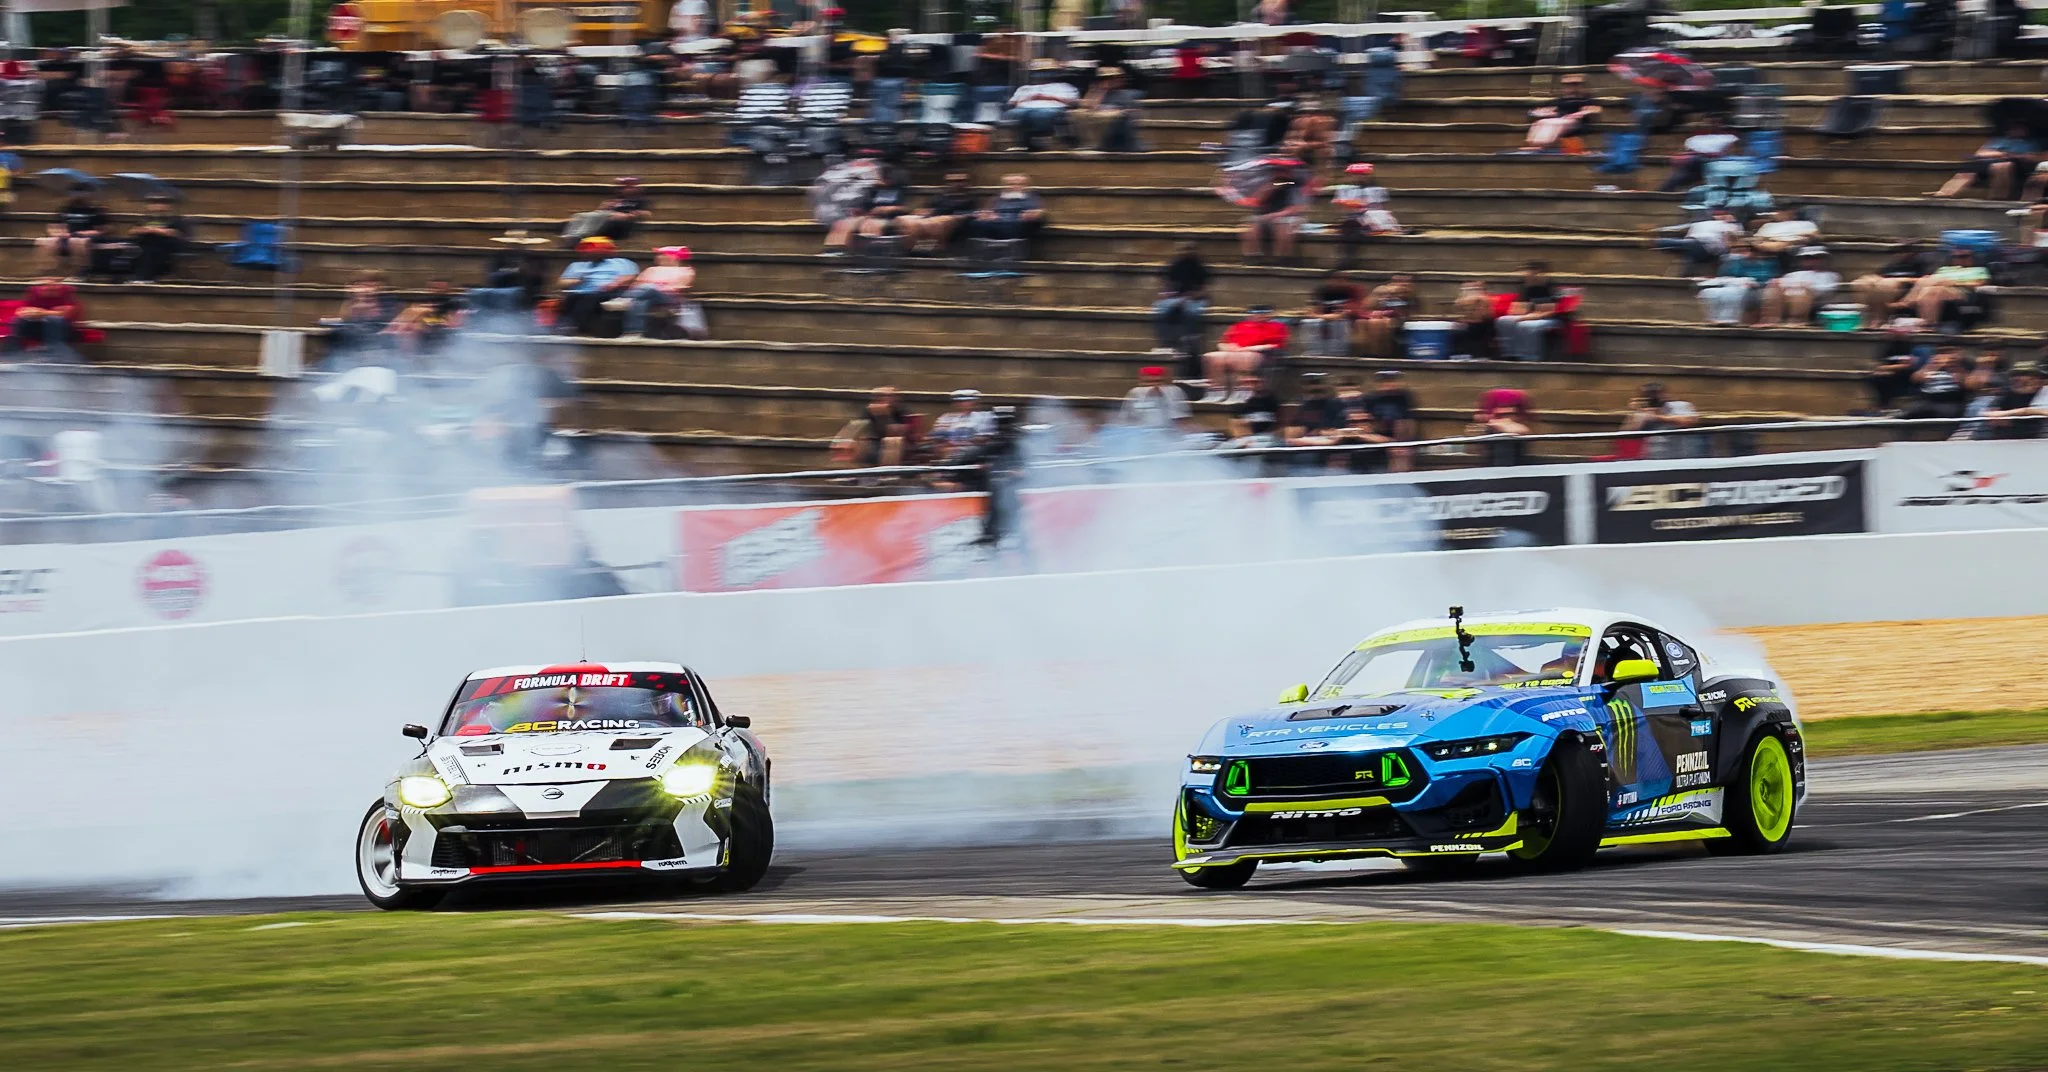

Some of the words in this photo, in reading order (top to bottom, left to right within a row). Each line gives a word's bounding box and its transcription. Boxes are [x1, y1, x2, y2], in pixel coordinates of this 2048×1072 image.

[513, 674, 577, 690] FORMULA
[580, 673, 629, 686] DRIFT
[1297, 721, 1409, 734] VEHICLES
[502, 761, 607, 776] nismo
[1676, 750, 1710, 774] PENNZOIL
[1270, 807, 1363, 820] NITTO
[1661, 805, 1682, 814] FORD
[1683, 799, 1712, 811] RACING
[1430, 844, 1485, 852] PENNZOIL
